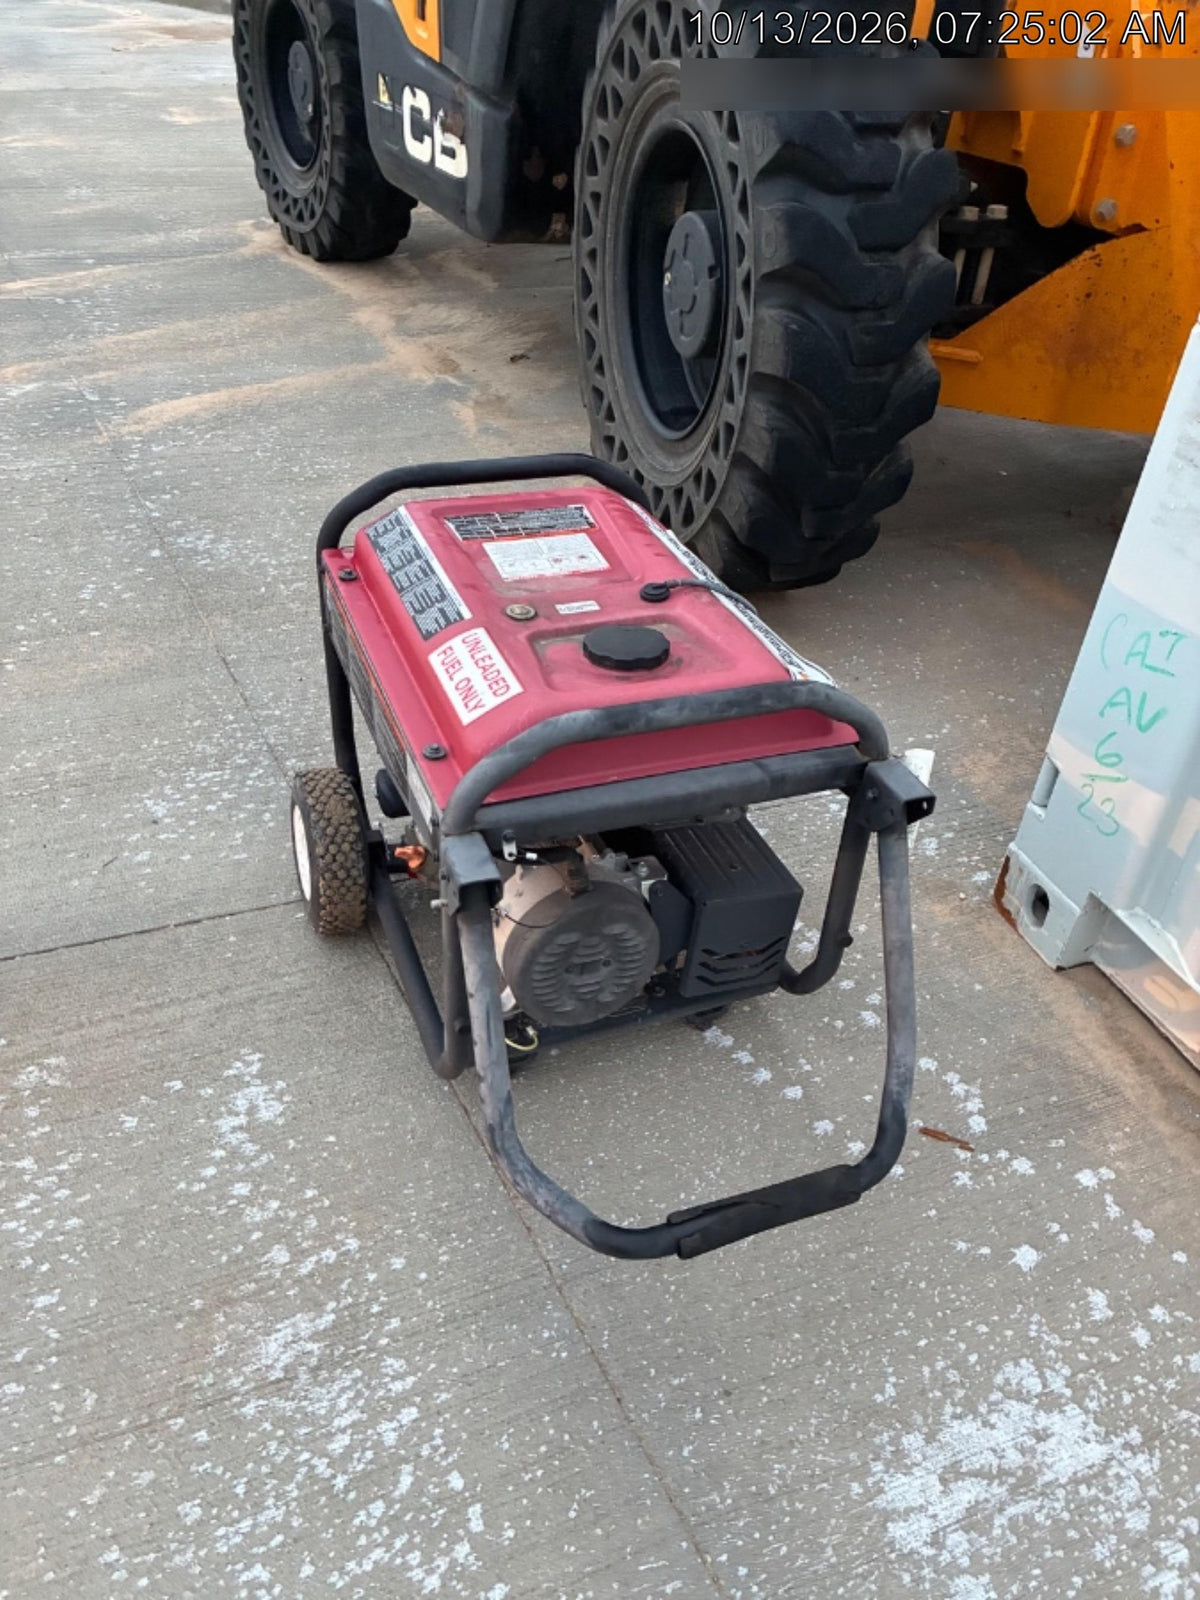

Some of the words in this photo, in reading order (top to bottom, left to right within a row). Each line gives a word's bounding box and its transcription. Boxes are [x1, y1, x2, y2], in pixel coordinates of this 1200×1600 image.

[437, 645, 464, 681] FUEL
[454, 677, 486, 713] ONLY
[461, 632, 511, 697] UNLEADED
